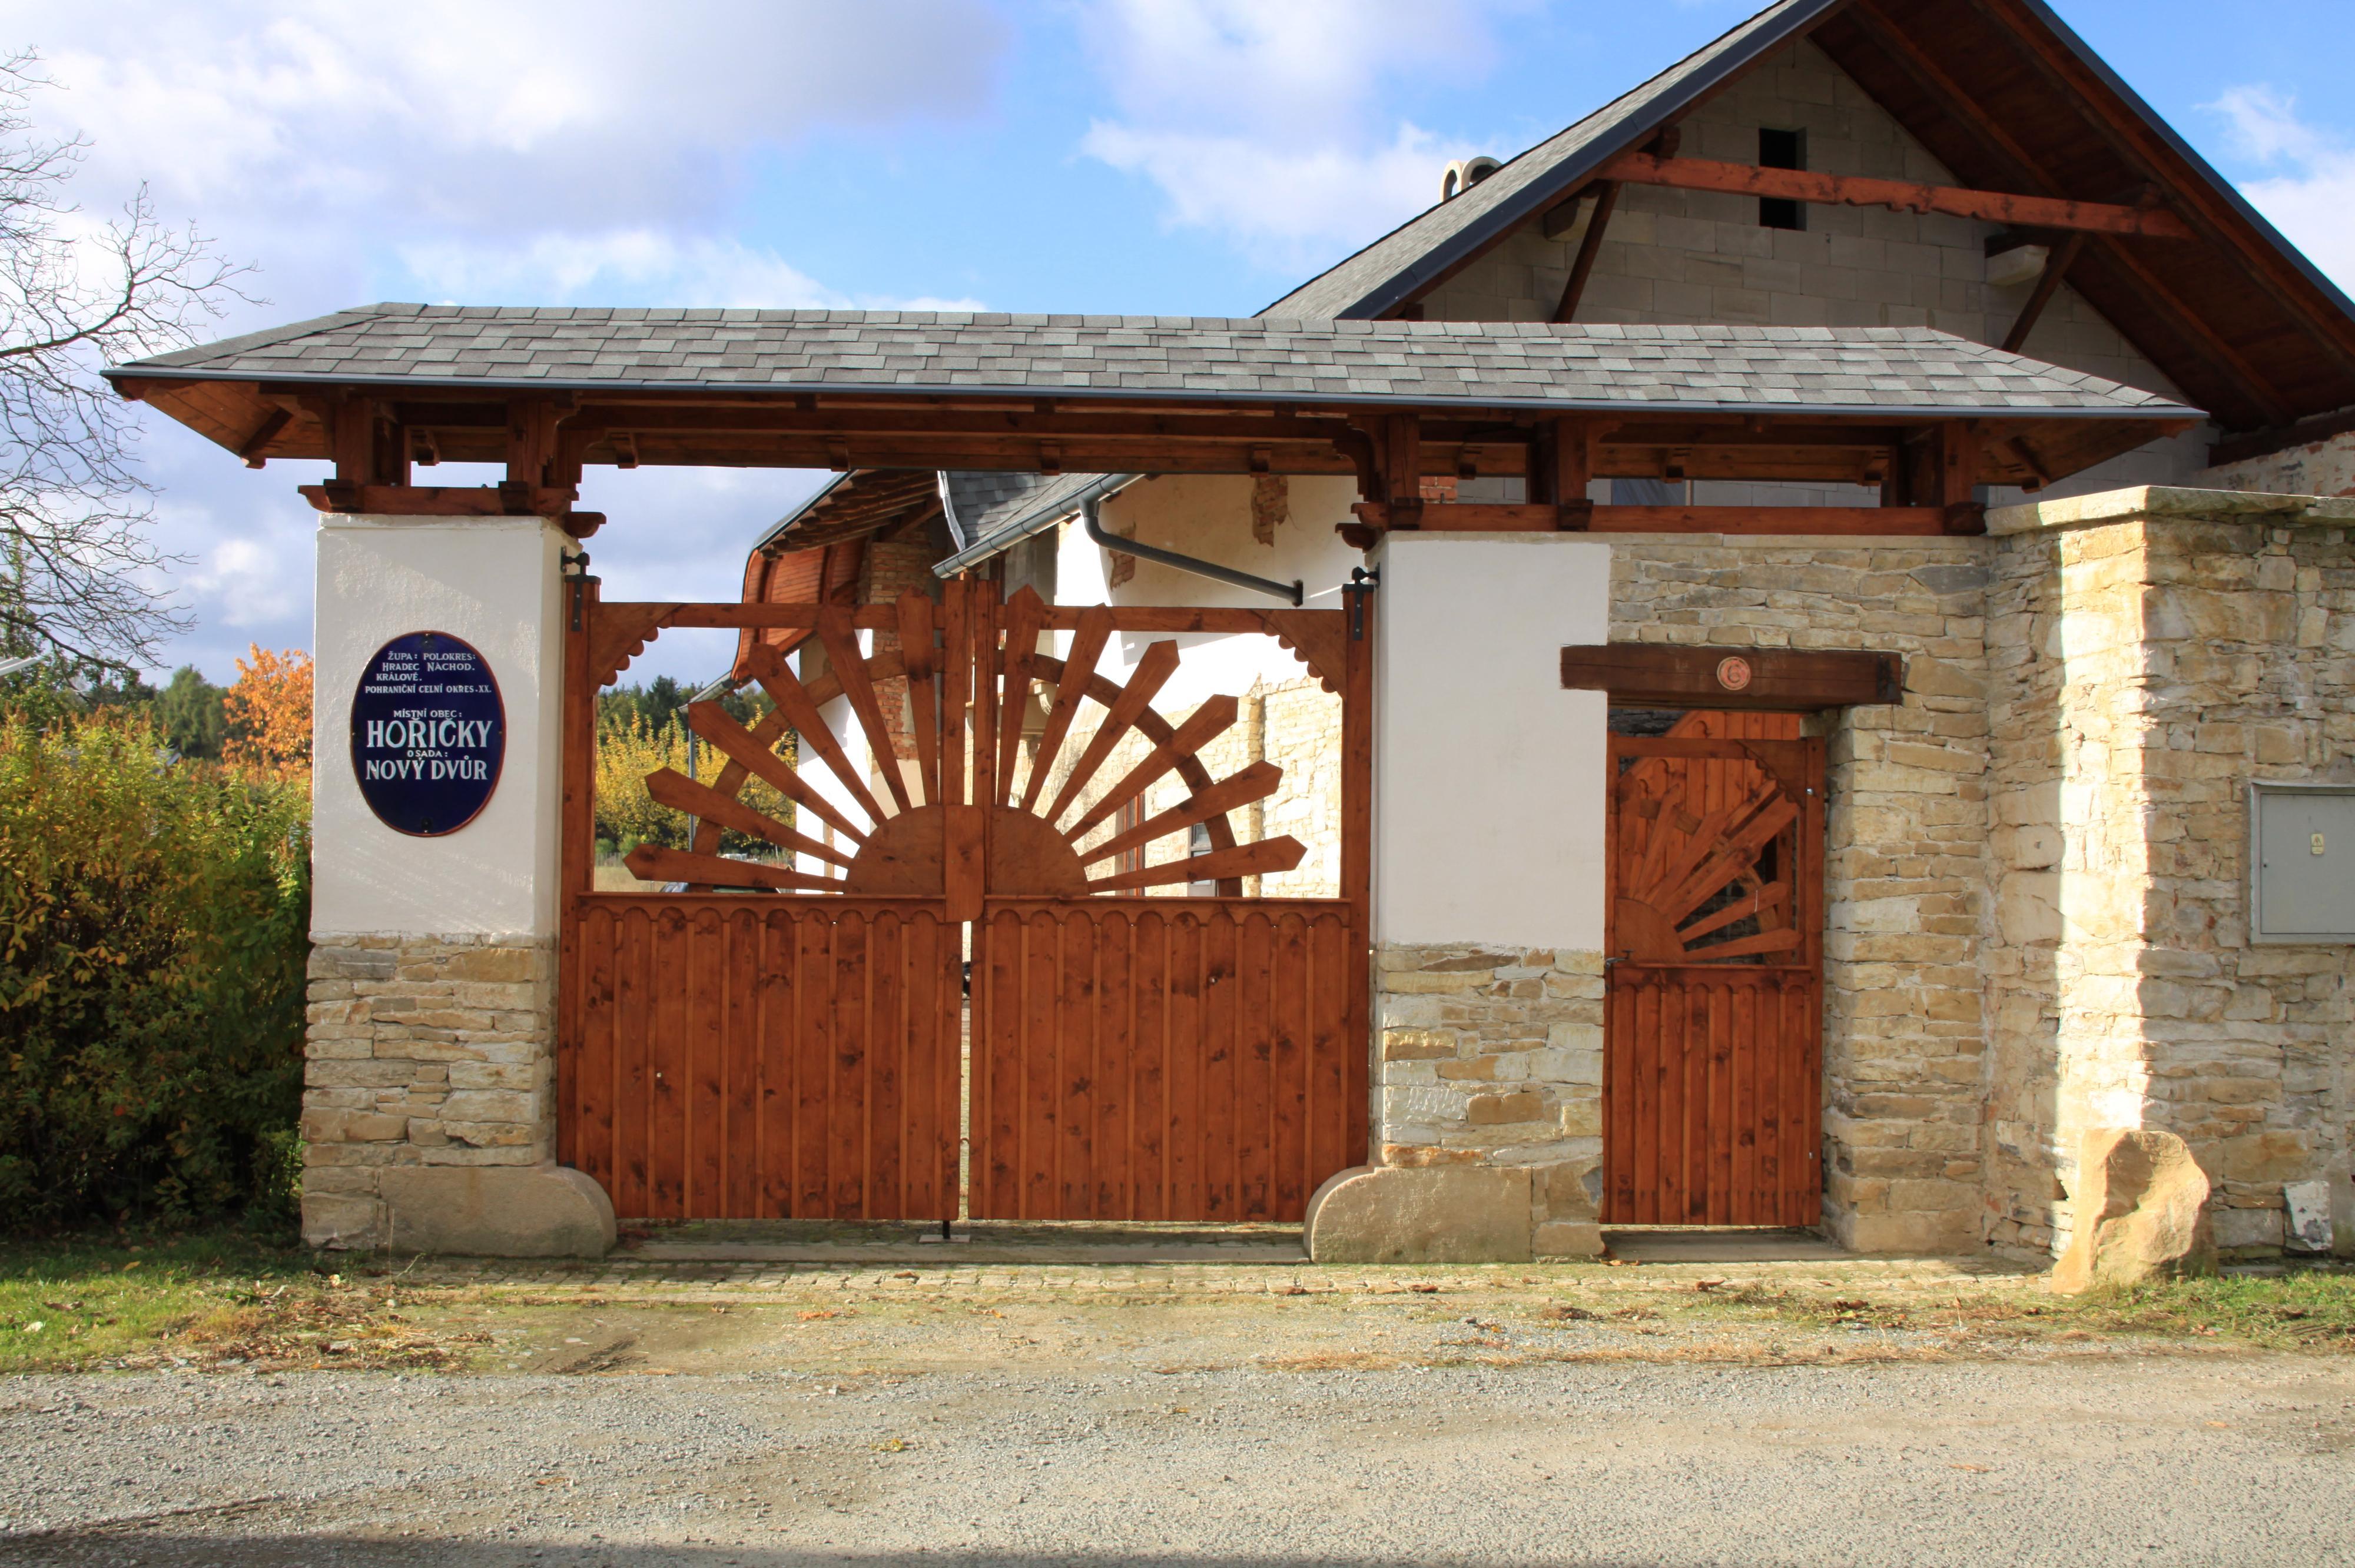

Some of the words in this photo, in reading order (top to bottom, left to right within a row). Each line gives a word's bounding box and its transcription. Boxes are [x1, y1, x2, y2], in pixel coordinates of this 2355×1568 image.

[423, 652, 476, 660] POLOKRES:
[383, 662, 420, 672] HRADEC
[376, 672, 422, 681] KRÁLOVÉ.
[1727, 664, 1741, 683] 6
[365, 684, 416, 693] POHRANIČNÍ
[419, 683, 443, 693] CELNÍ
[393, 708, 427, 717] MÍSTNÍ
[366, 717, 493, 748] HOŘIČKY
[366, 757, 425, 780] NOVÝ
[431, 755, 488, 780] DVŮR
